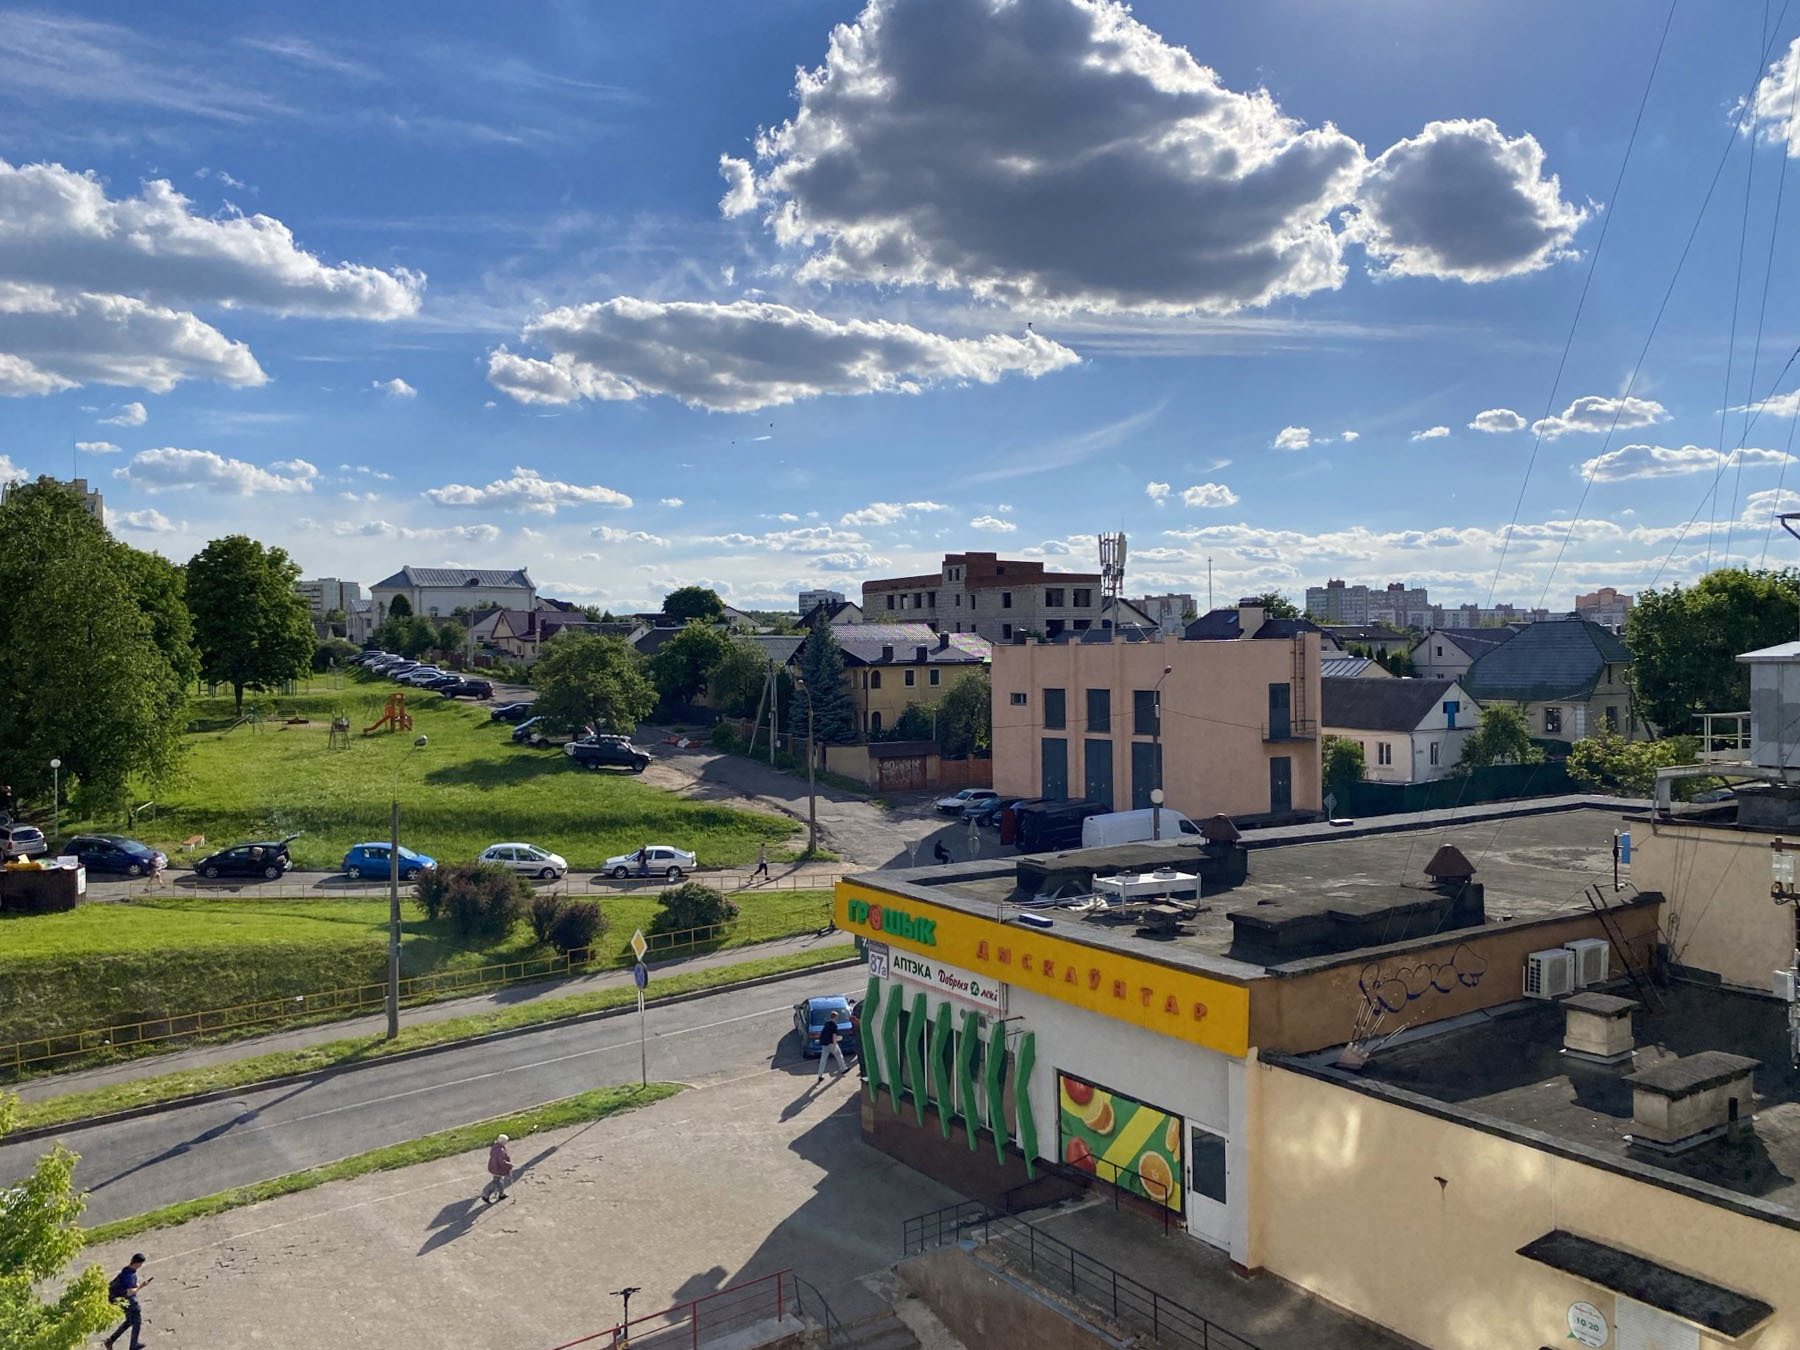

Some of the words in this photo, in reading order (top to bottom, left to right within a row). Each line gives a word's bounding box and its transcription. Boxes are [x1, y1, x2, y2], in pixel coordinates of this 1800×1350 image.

[848, 899, 937, 946] ГРОШЫК
[893, 955, 932, 980] АПТЭКА
[938, 969, 969, 991] Добрыя
